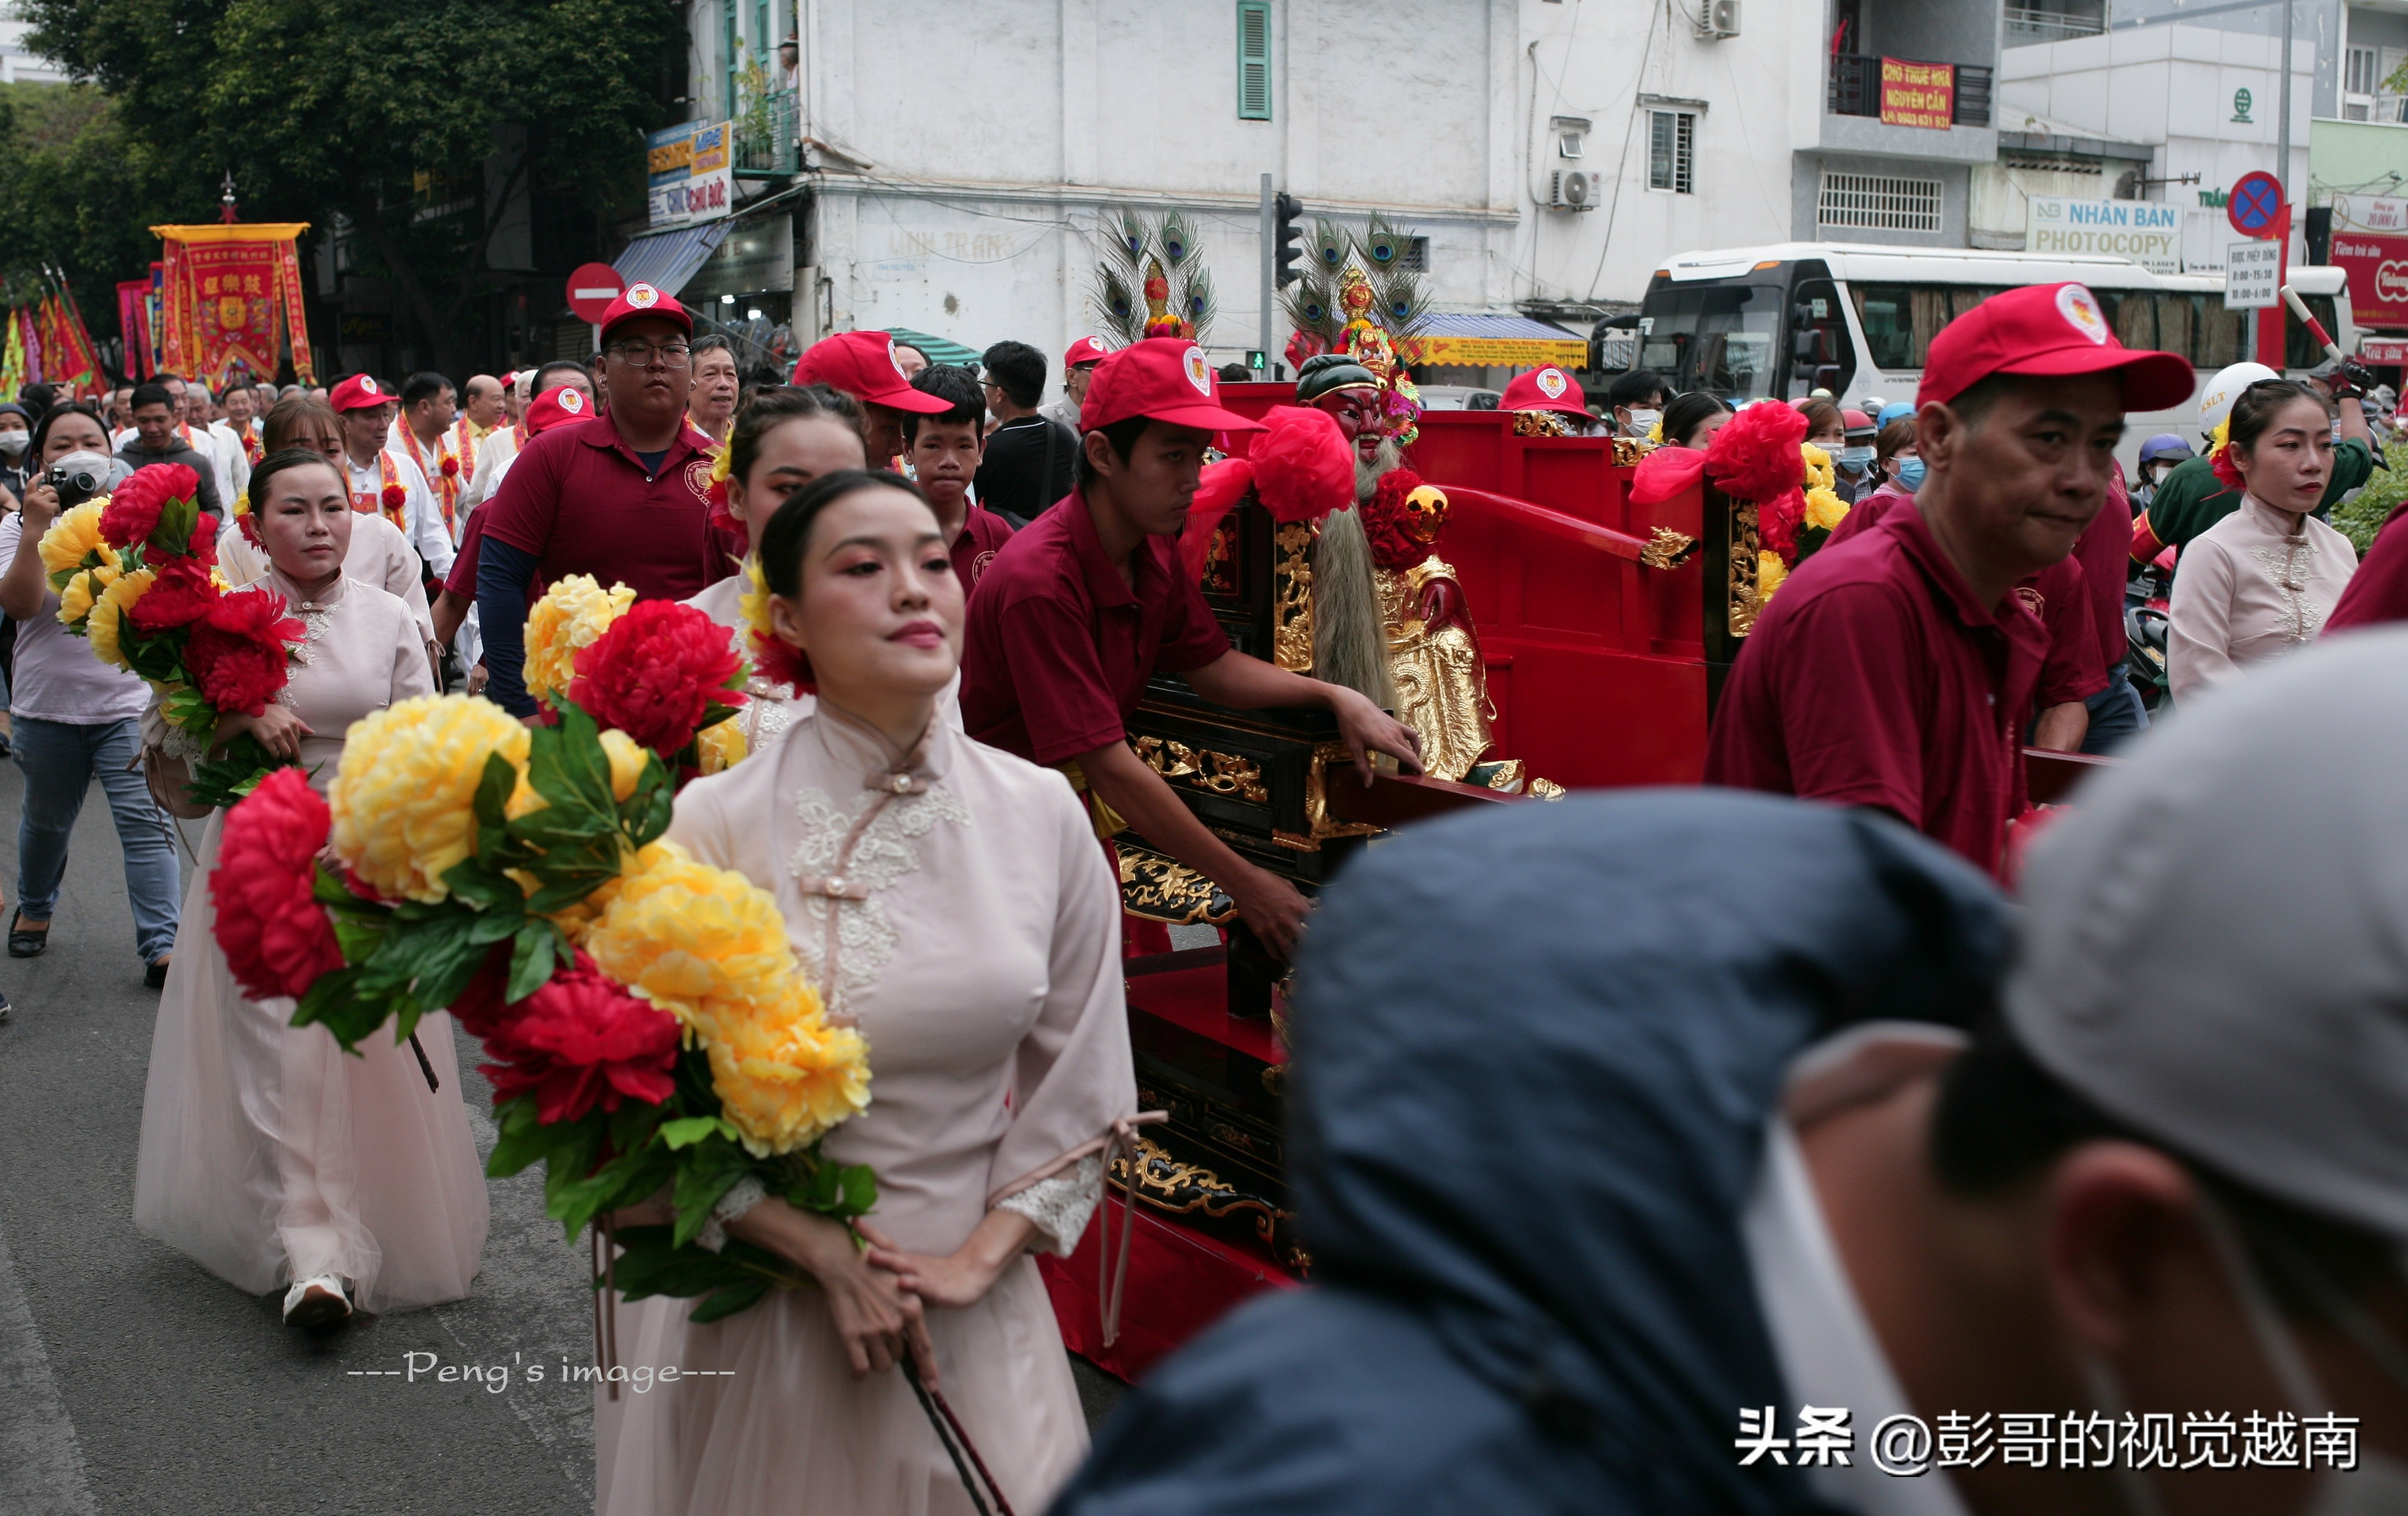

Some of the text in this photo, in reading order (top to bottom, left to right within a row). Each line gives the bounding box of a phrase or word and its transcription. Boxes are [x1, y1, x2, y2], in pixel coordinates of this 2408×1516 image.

[1883, 63, 1902, 82] CHO
[2070, 199, 2128, 225] NHÂN
[2134, 201, 2175, 227] BẢN
[2036, 229, 2173, 256] PHOTOCOPY
